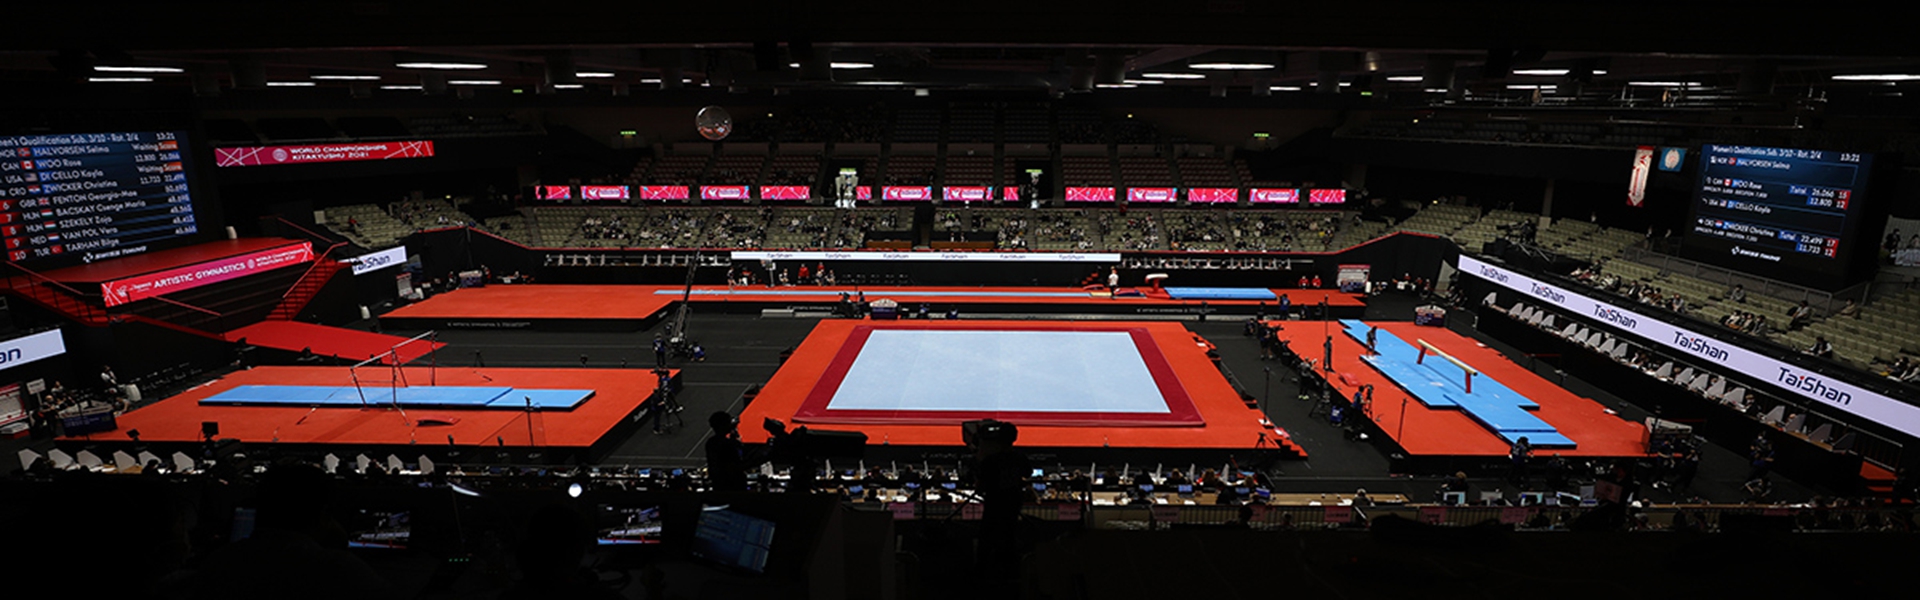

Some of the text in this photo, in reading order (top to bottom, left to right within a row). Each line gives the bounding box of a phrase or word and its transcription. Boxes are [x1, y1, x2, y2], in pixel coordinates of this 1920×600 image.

[19, 136, 71, 146] Qualification
[126, 132, 139, 142] 2/4
[132, 143, 158, 152] Waiting
[1810, 150, 1822, 160] 2/4
[1840, 153, 1860, 162] 13:21
[1, 162, 20, 171] CAN
[36, 158, 82, 169] WOO Rose
[136, 163, 182, 174] Waiting Score
[5, 174, 24, 184] USA
[51, 170, 80, 180] CELLO
[81, 169, 104, 178] Kayla
[53, 194, 87, 204] FENTON
[1810, 198, 1832, 207] 12.800
[6, 214, 12, 222] 7
[22, 212, 40, 221] HUN
[26, 224, 44, 234] HUN
[62, 229, 82, 240] VAN
[1779, 231, 1796, 240] Total
[66, 240, 100, 251] TARHAN
[15, 252, 26, 260] 10
[34, 246, 50, 257] TUR
[154, 274, 194, 288] ARTISTIC
[195, 262, 246, 280] GYMNASTICS
[1480, 265, 1508, 283] TaiShan
[1530, 282, 1565, 304] TaiShan
[1594, 304, 1637, 329] TaiShan
[1674, 331, 1729, 362] TaiShan
[1778, 367, 1852, 405] TaiShan
